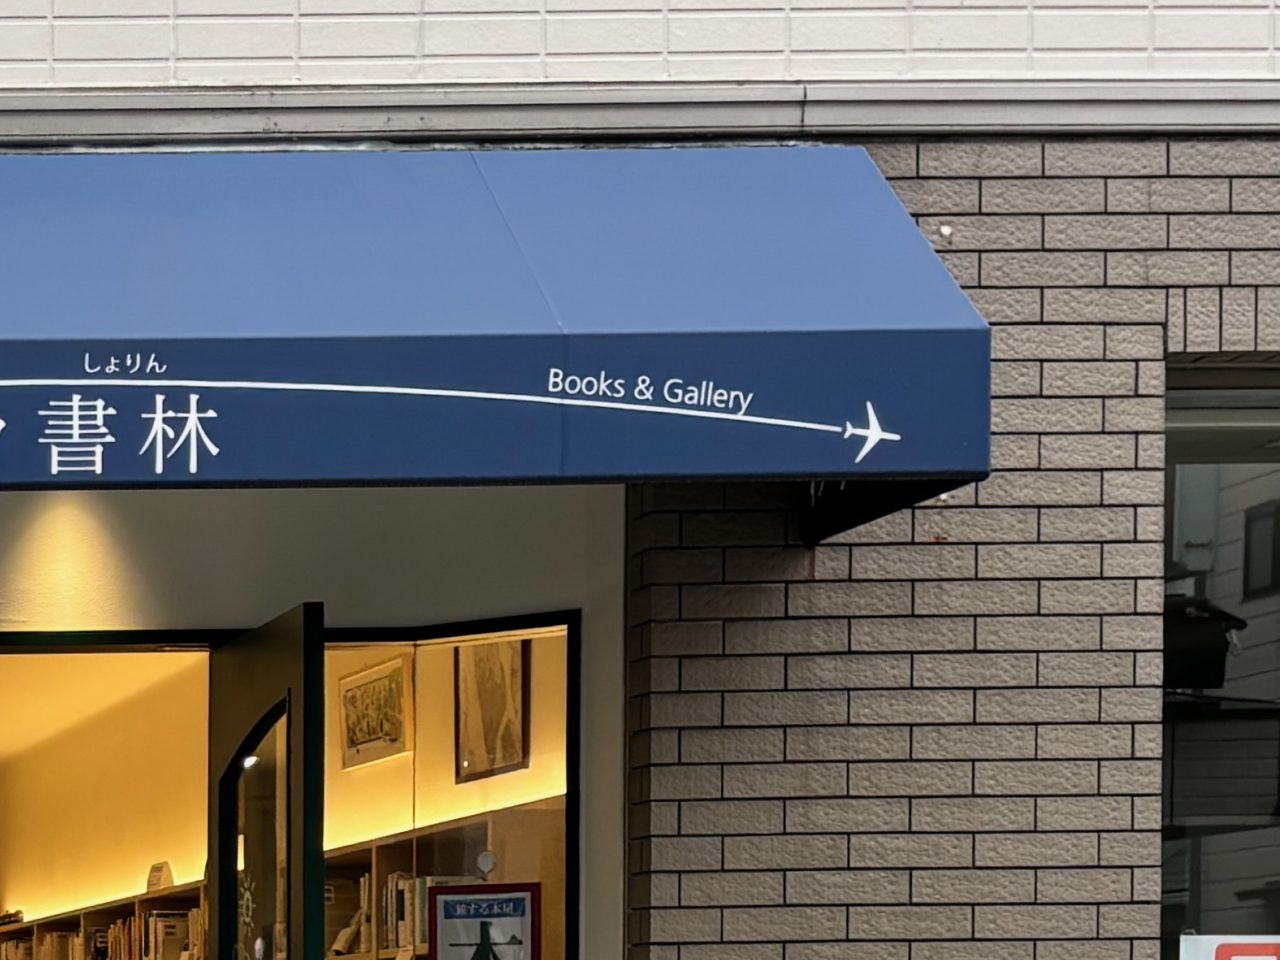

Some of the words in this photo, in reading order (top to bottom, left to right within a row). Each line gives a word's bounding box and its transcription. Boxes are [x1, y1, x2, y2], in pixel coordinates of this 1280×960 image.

[82, 351, 168, 374] しょりん
[547, 367, 626, 399] Books
[633, 375, 655, 401] &
[663, 377, 754, 416] Gallery
